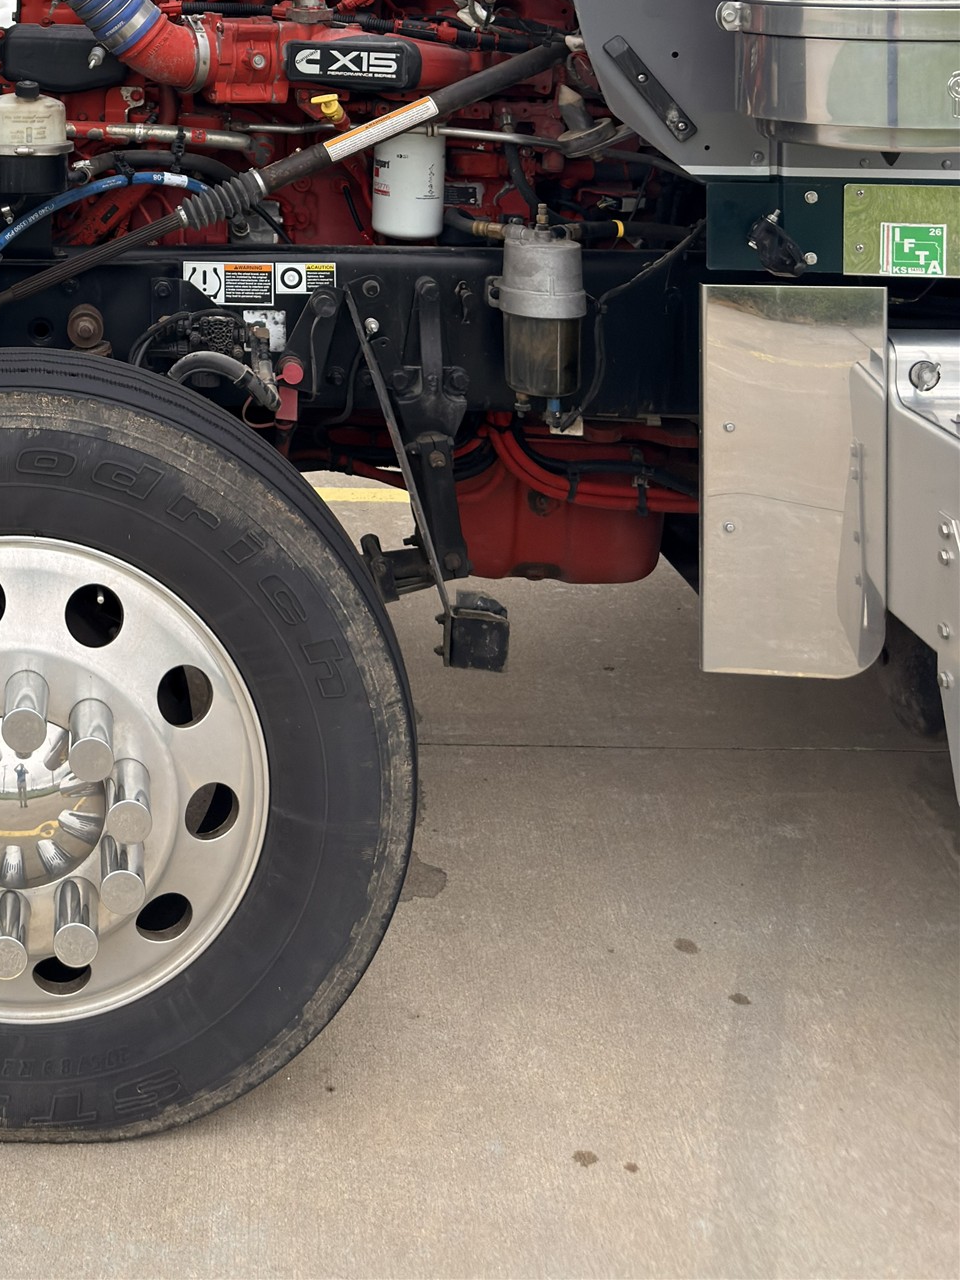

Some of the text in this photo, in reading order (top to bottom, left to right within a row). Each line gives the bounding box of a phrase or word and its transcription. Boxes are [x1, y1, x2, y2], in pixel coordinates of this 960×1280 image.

[327, 50, 398, 74] X15
[928, 228, 942, 236] 26
[892, 266, 908, 274] KS
